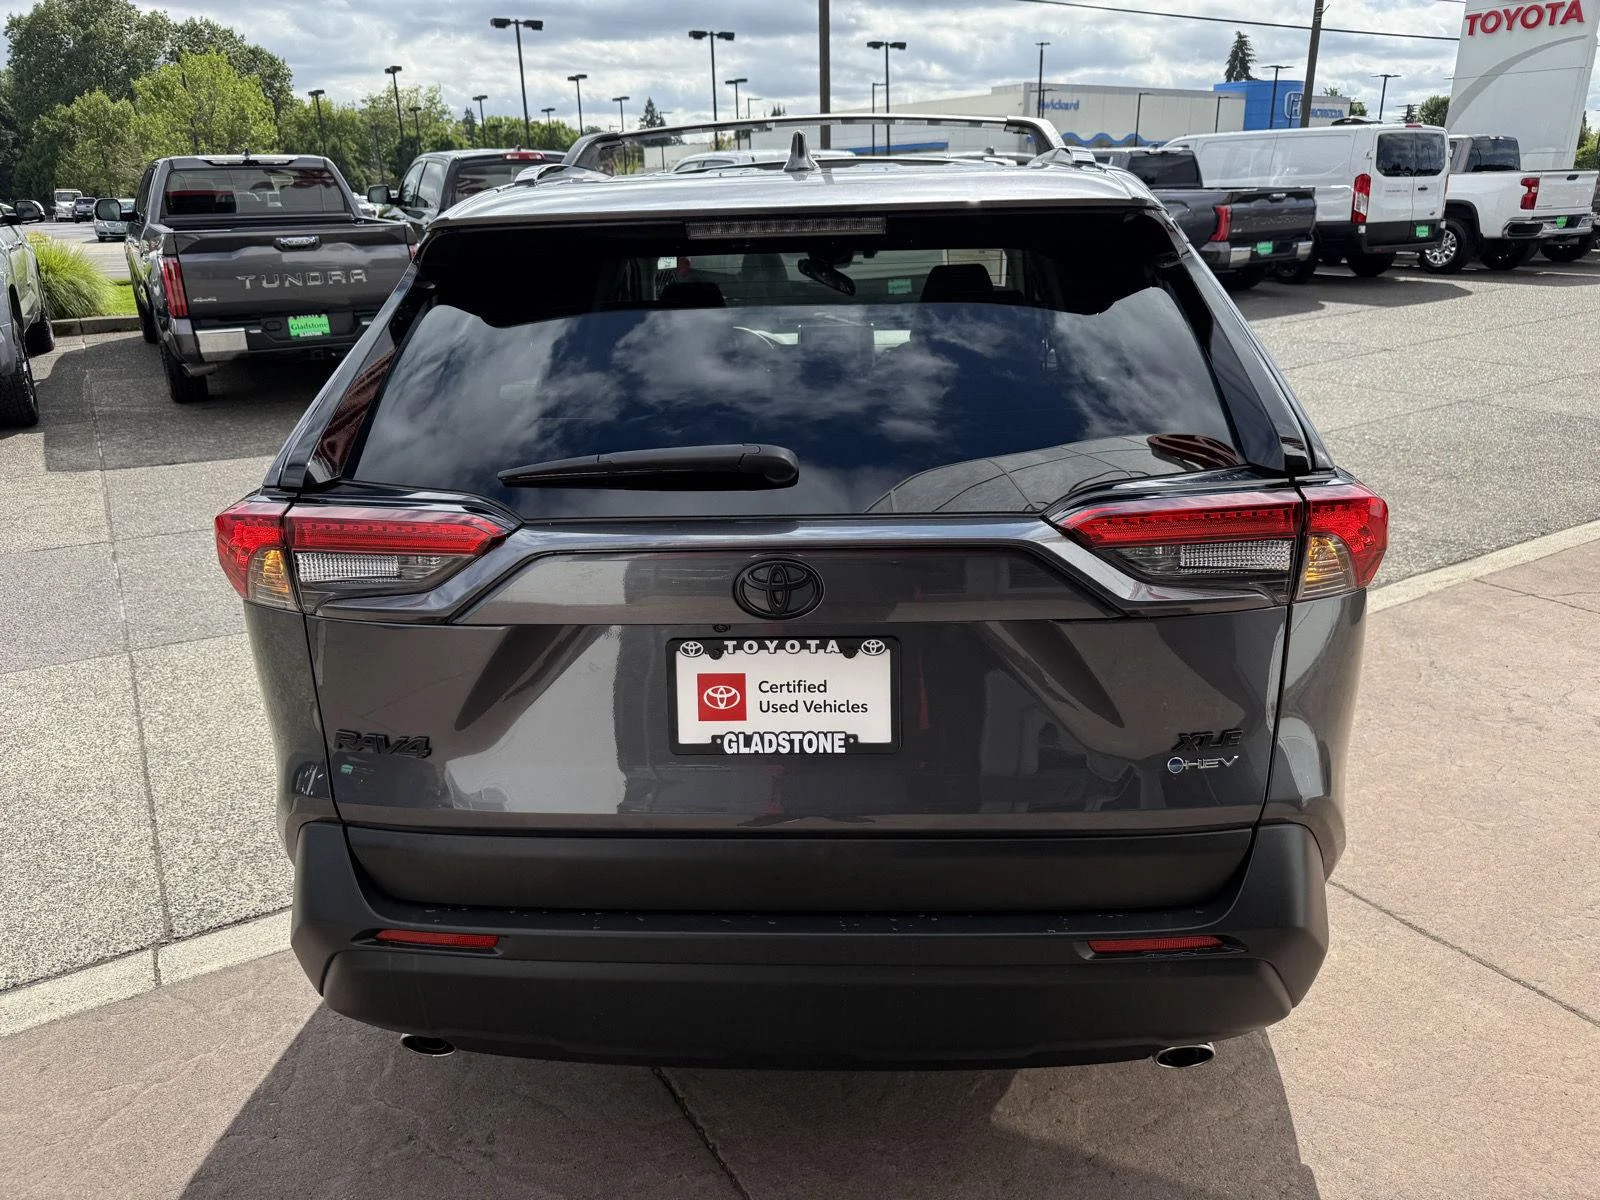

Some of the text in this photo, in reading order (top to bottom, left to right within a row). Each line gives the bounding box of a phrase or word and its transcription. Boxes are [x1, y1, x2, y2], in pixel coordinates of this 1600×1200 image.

[1465, 0, 1584, 36] TOYOTA
[236, 269, 368, 290] TUNDRA
[724, 640, 841, 655] TOYOTA
[758, 680, 828, 694] Certified
[759, 700, 868, 714] Used Vehicles
[335, 729, 432, 759] RAV4
[723, 732, 846, 754] GLADSTONE
[1171, 728, 1243, 751] XLE
